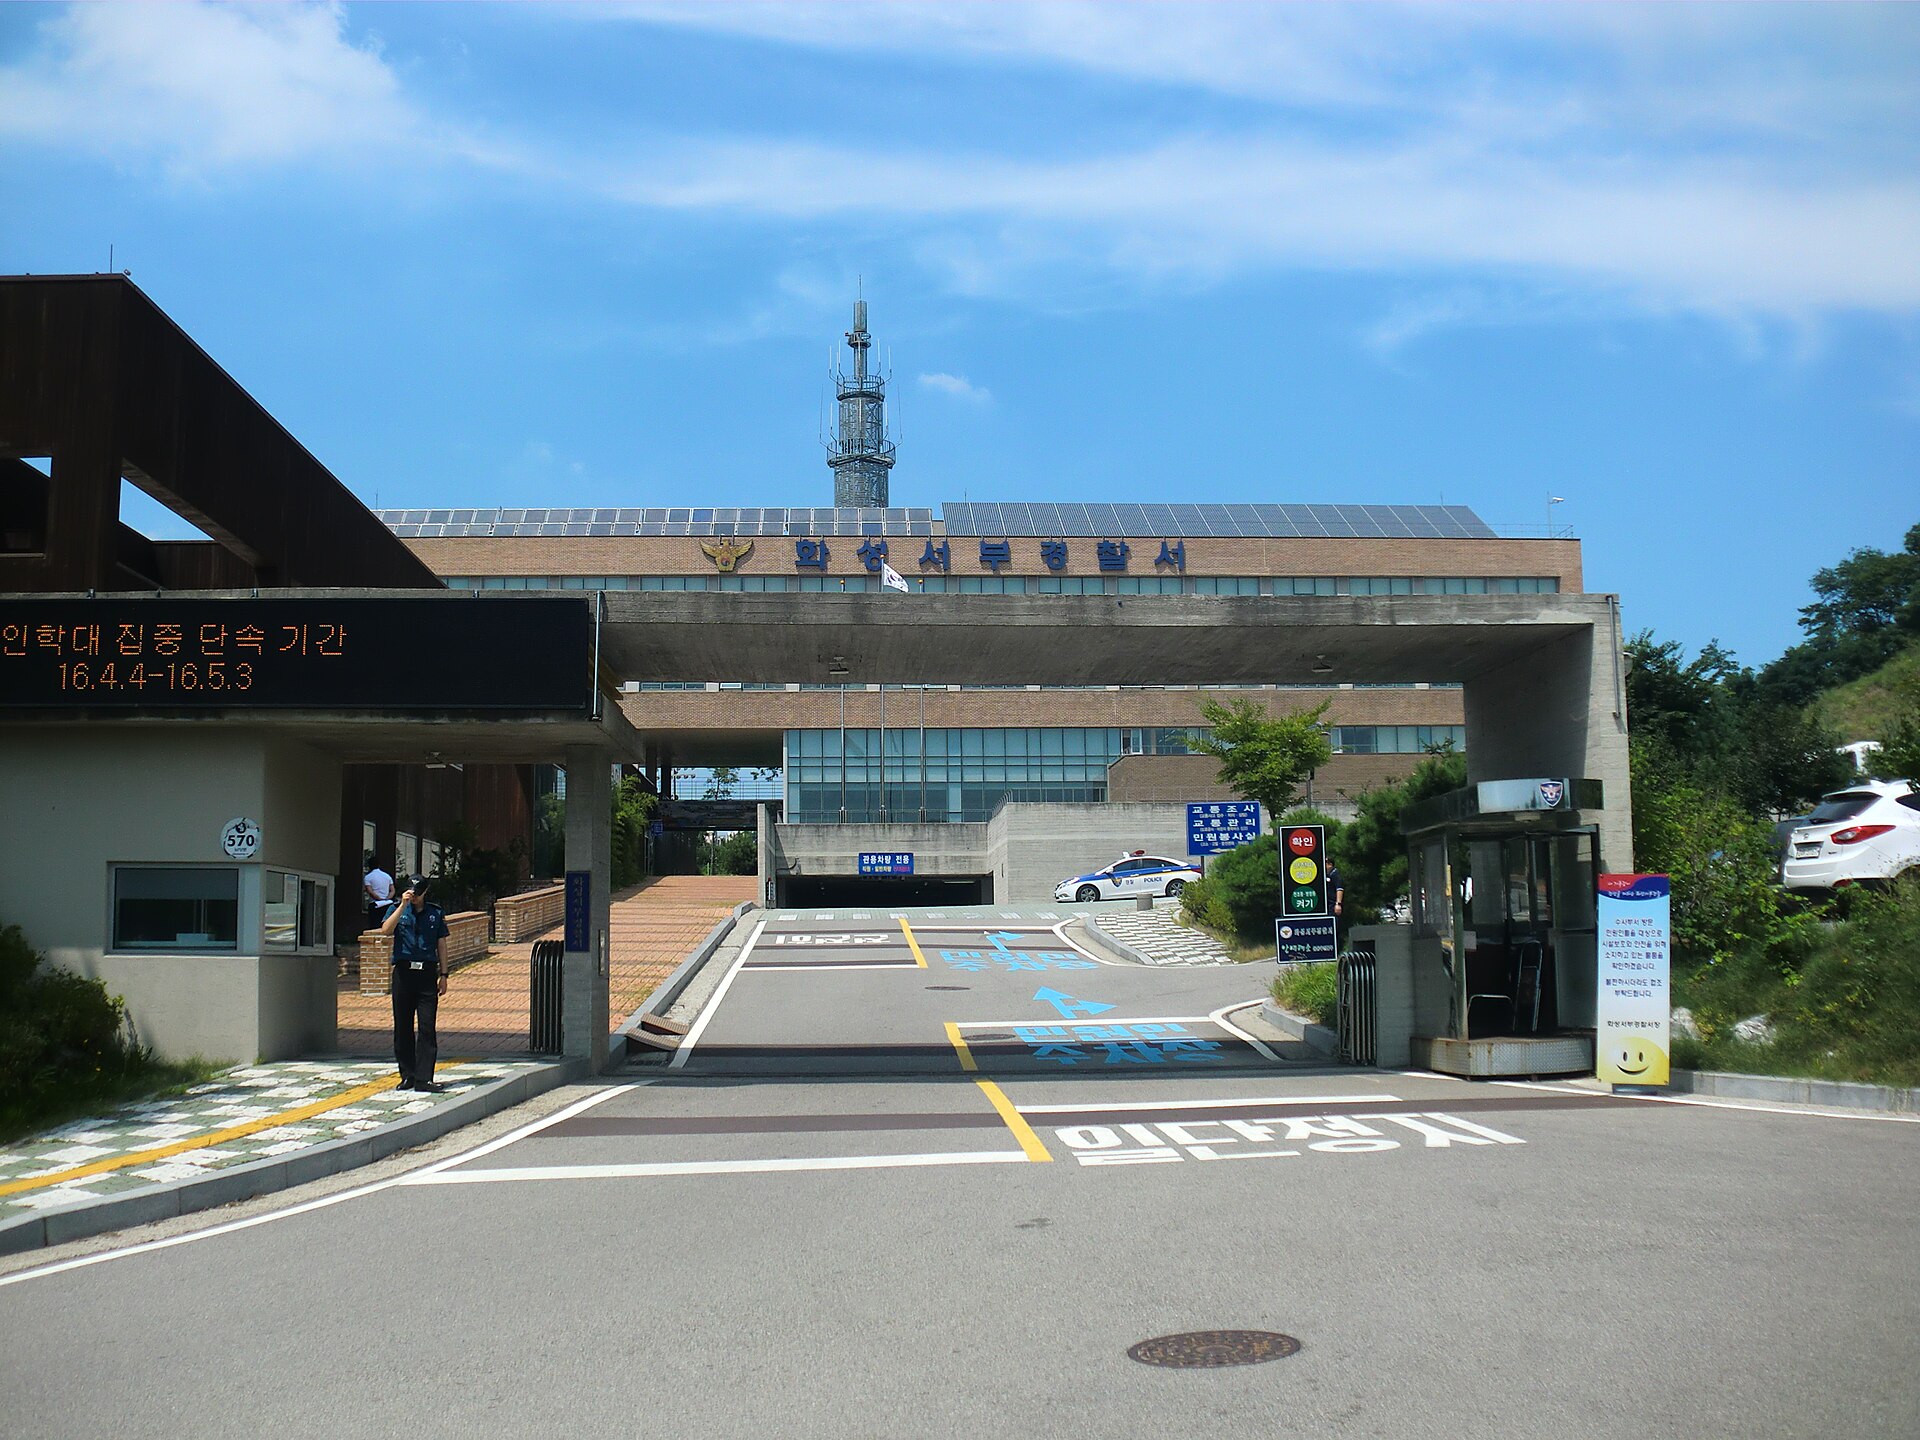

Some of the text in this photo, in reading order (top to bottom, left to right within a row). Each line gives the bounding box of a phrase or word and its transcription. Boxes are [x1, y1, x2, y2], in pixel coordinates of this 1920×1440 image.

[794, 537, 1186, 572] 화성서부경찰서
[2, 623, 348, 656] 인학대 집중 단속 기간
[58, 662, 254, 691] 16.4.4-16.5.3
[1192, 804, 1255, 814] 교통조사
[1192, 818, 1256, 828] 교통관리
[227, 834, 255, 847] 570
[1192, 831, 1257, 842] 민원봉사실
[1292, 837, 1313, 847] 확인
[940, 950, 1082, 963] 민원인
[949, 960, 1099, 972] 주차장
[1014, 1023, 1200, 1045] 민원인
[1028, 1040, 1224, 1068] 주차장
[1054, 1112, 1527, 1166] 일단정지
